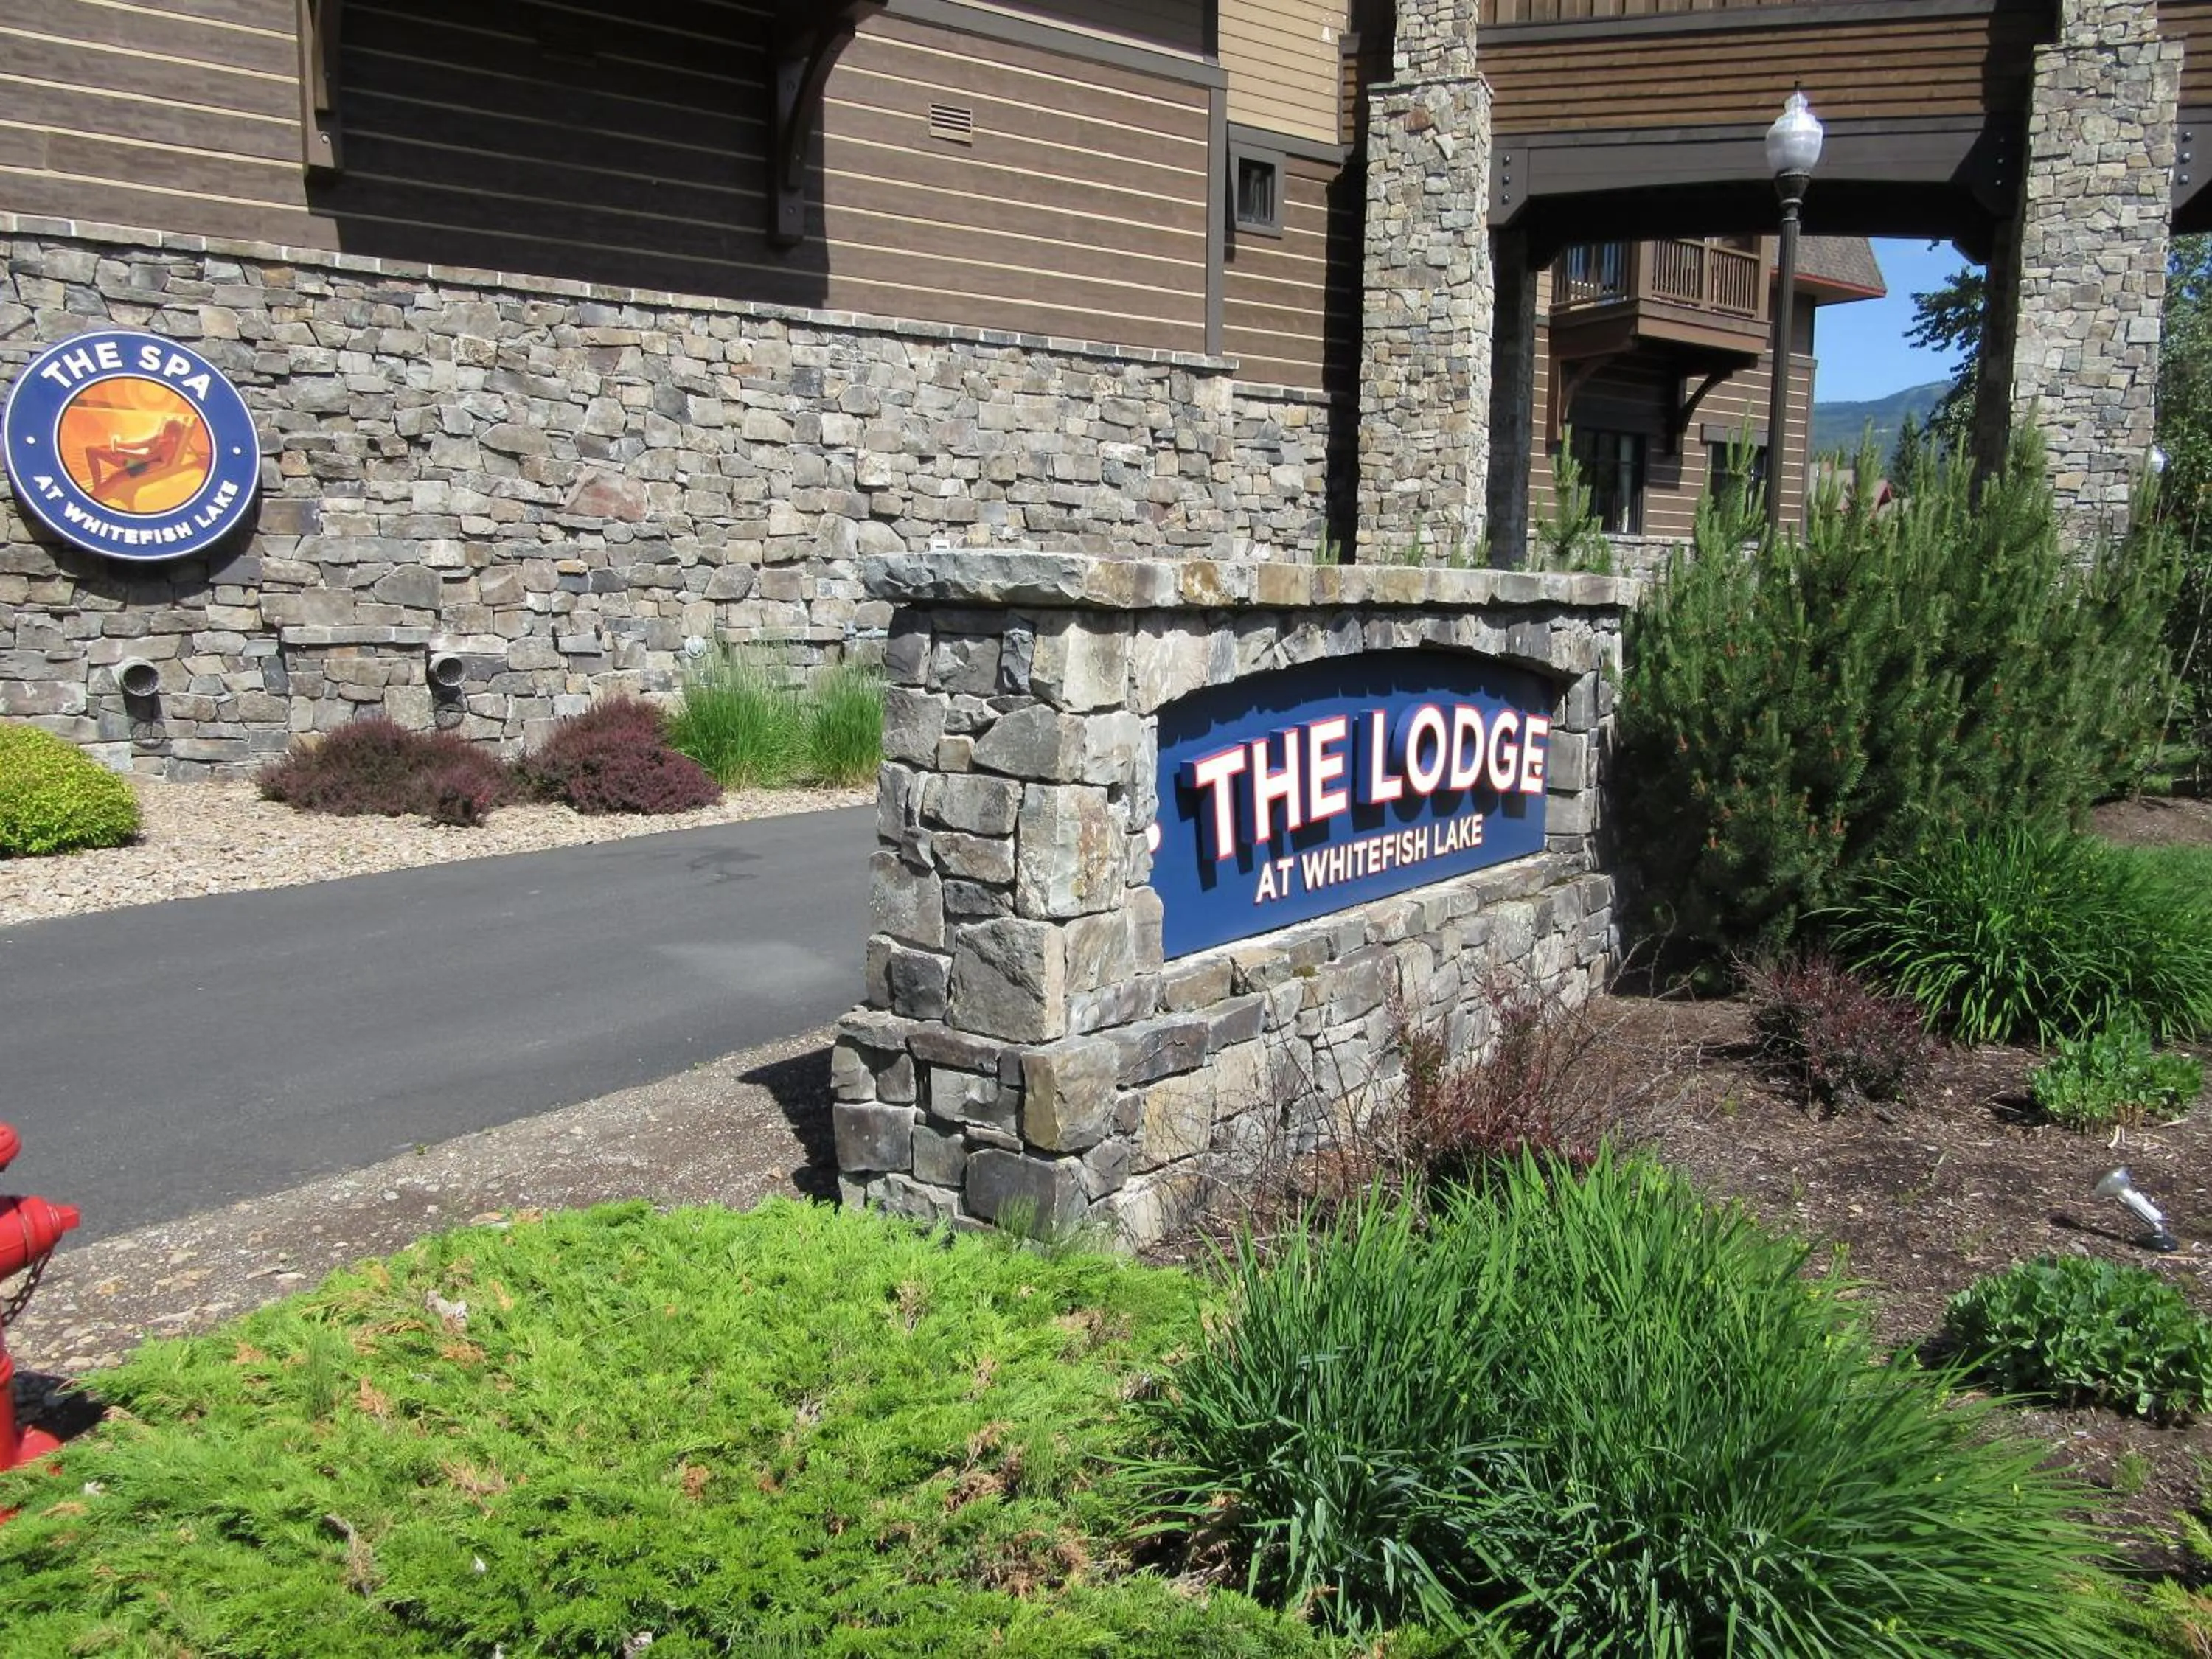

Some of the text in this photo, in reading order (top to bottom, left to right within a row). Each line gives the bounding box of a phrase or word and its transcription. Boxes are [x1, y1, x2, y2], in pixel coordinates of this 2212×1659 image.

[41, 341, 212, 401] THE SPA
[34, 476, 238, 545] AT WHITEFISH LAKE
[1194, 702, 1549, 861] THE LODGE
[1255, 813, 1483, 905] AT WHITEFISH LAKE
